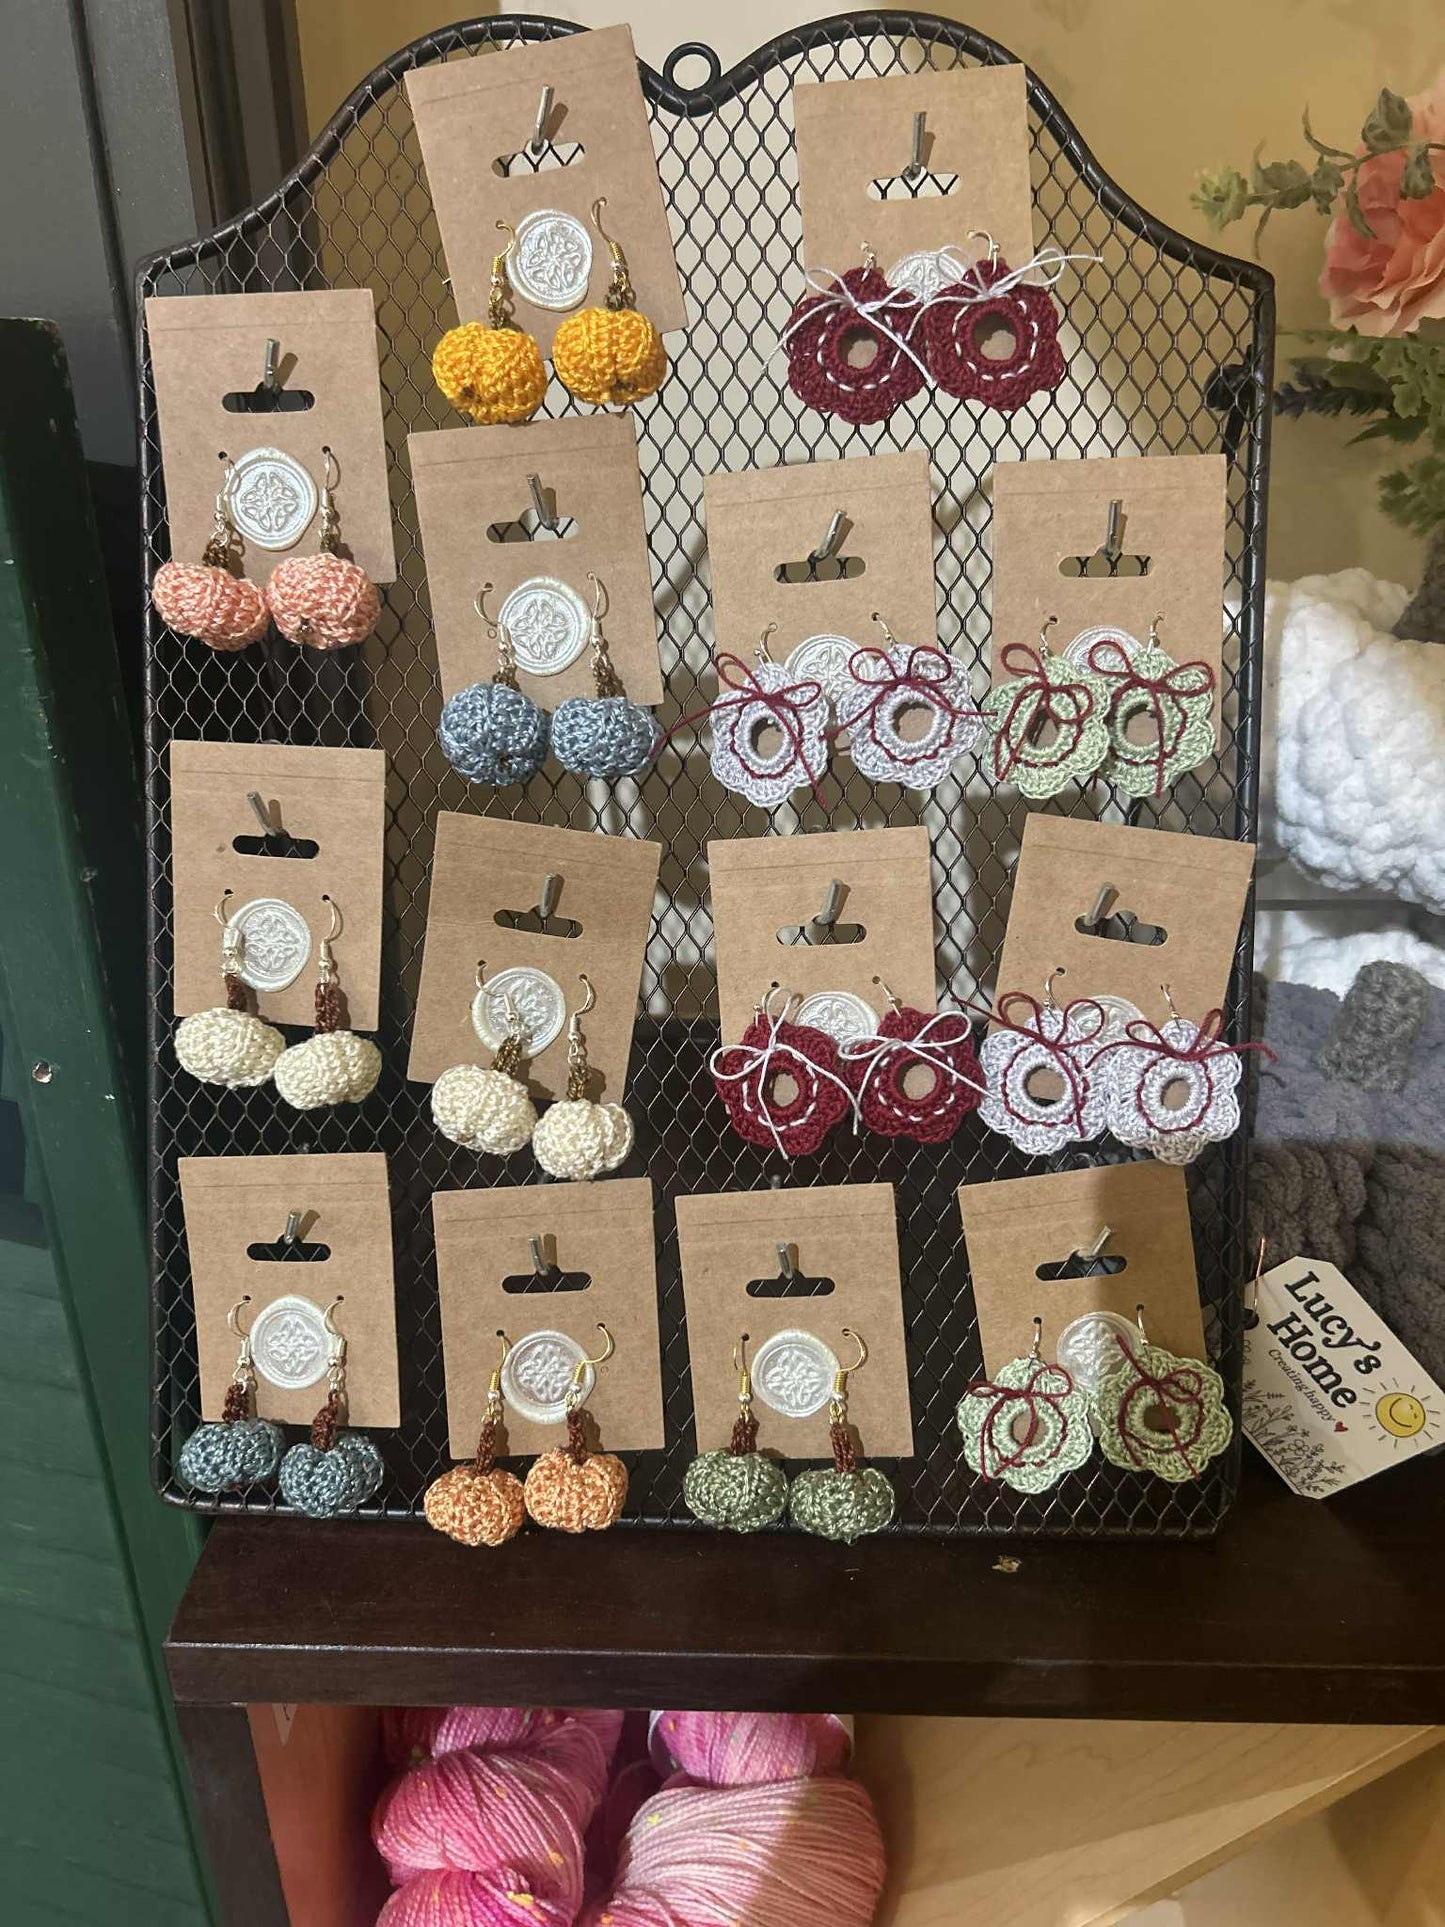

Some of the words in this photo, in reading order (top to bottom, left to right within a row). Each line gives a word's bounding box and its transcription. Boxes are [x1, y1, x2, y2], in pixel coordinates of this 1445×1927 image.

[1267, 1311, 1357, 1408] Home
[1285, 1271, 1381, 1374] Lucy's
[1268, 1349, 1308, 1391] Creating
[1303, 1390, 1336, 1421] happy
